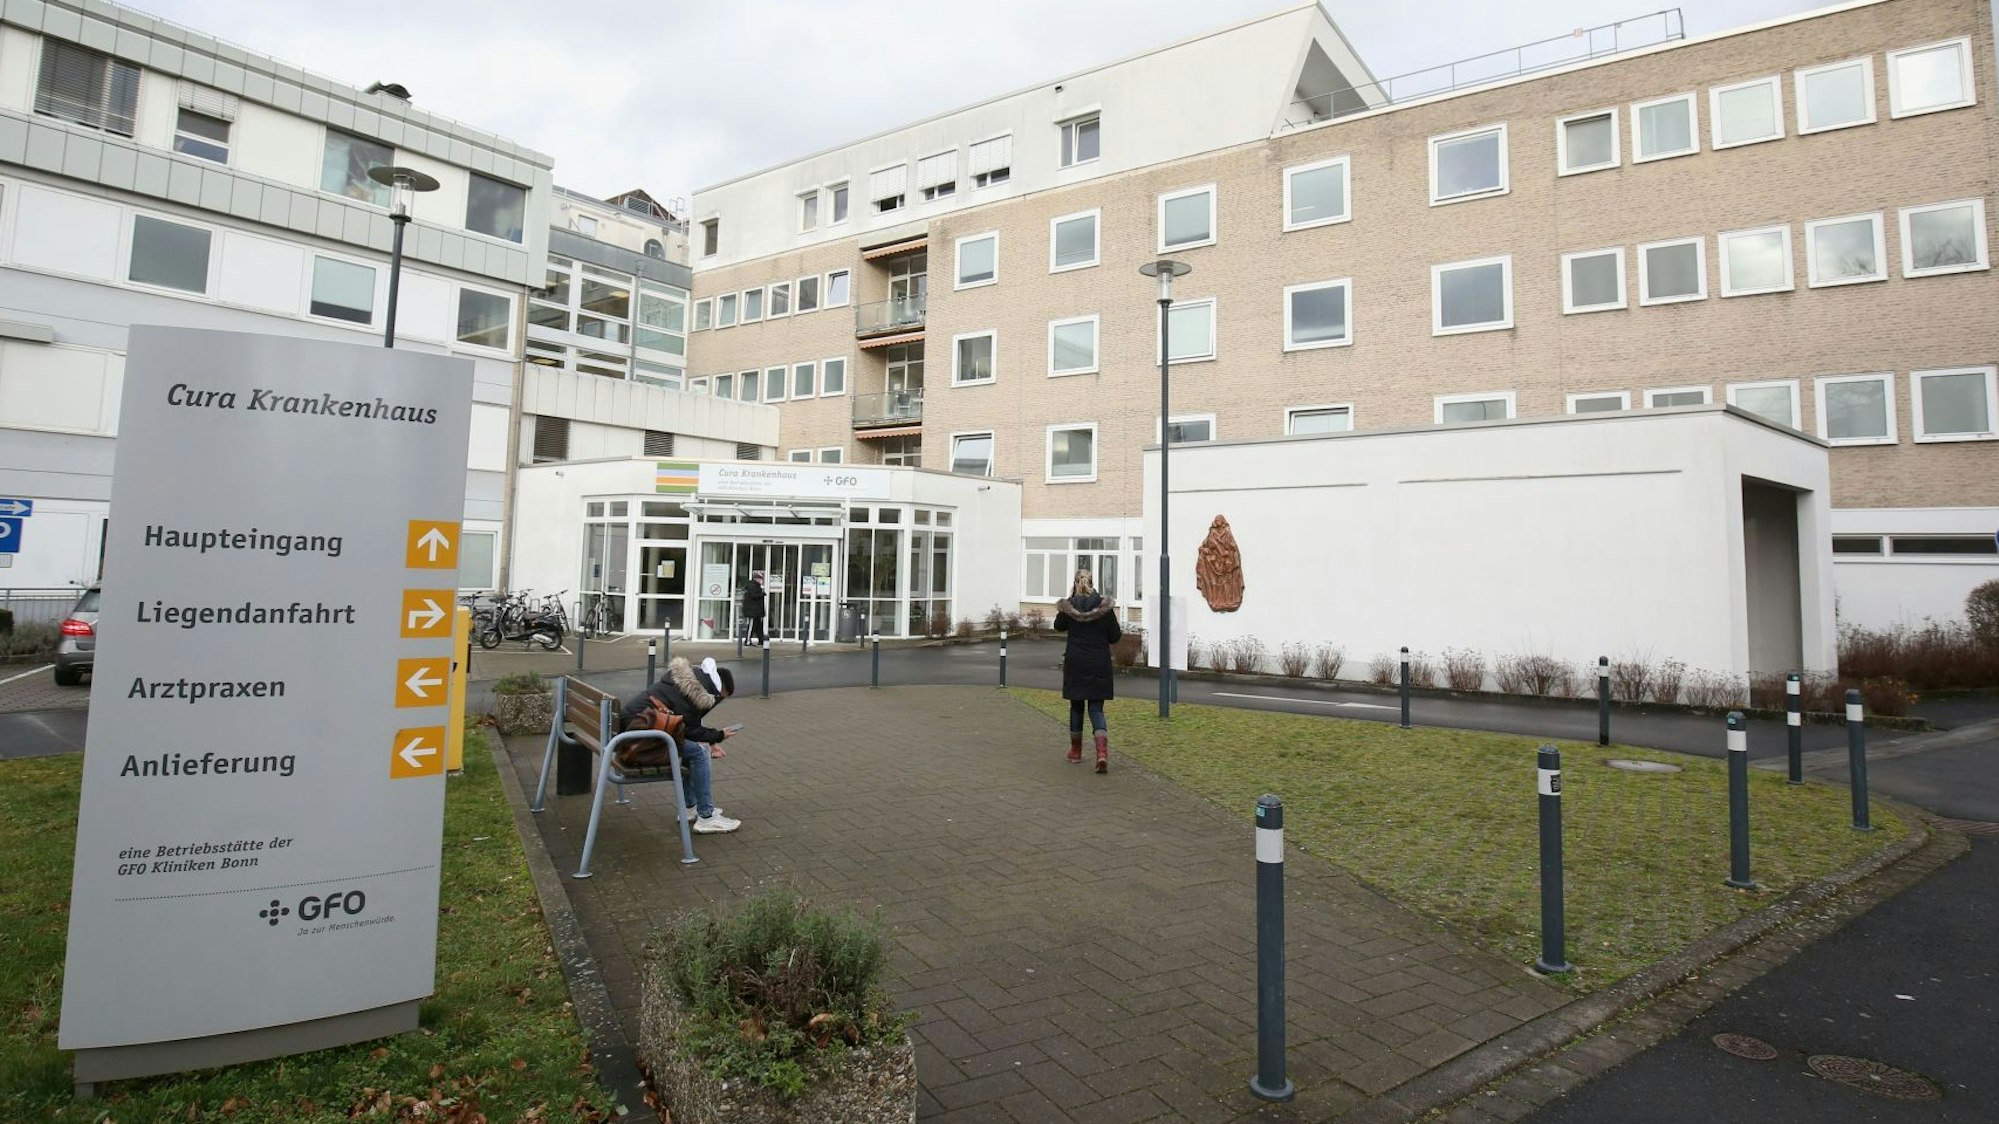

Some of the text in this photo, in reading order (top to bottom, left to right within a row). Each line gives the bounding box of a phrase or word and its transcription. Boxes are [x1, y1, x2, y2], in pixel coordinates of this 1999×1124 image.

[167, 383, 438, 425] Cura Krankenhaus
[718, 468, 797, 479] Cura Krankenhaus
[835, 476, 858, 486] GFO
[144, 525, 343, 557] Haupteingang
[136, 600, 356, 628] Liegendanfahrt
[127, 676, 286, 704] Arztpraxen
[120, 752, 296, 778] Anlieferung
[118, 836, 294, 859] eine Betriebsstätte der
[117, 856, 259, 876] GFO Kliniken Bonn
[298, 890, 366, 922] GFO
[297, 927, 309, 936] Ja
[311, 925, 326, 935] zur
